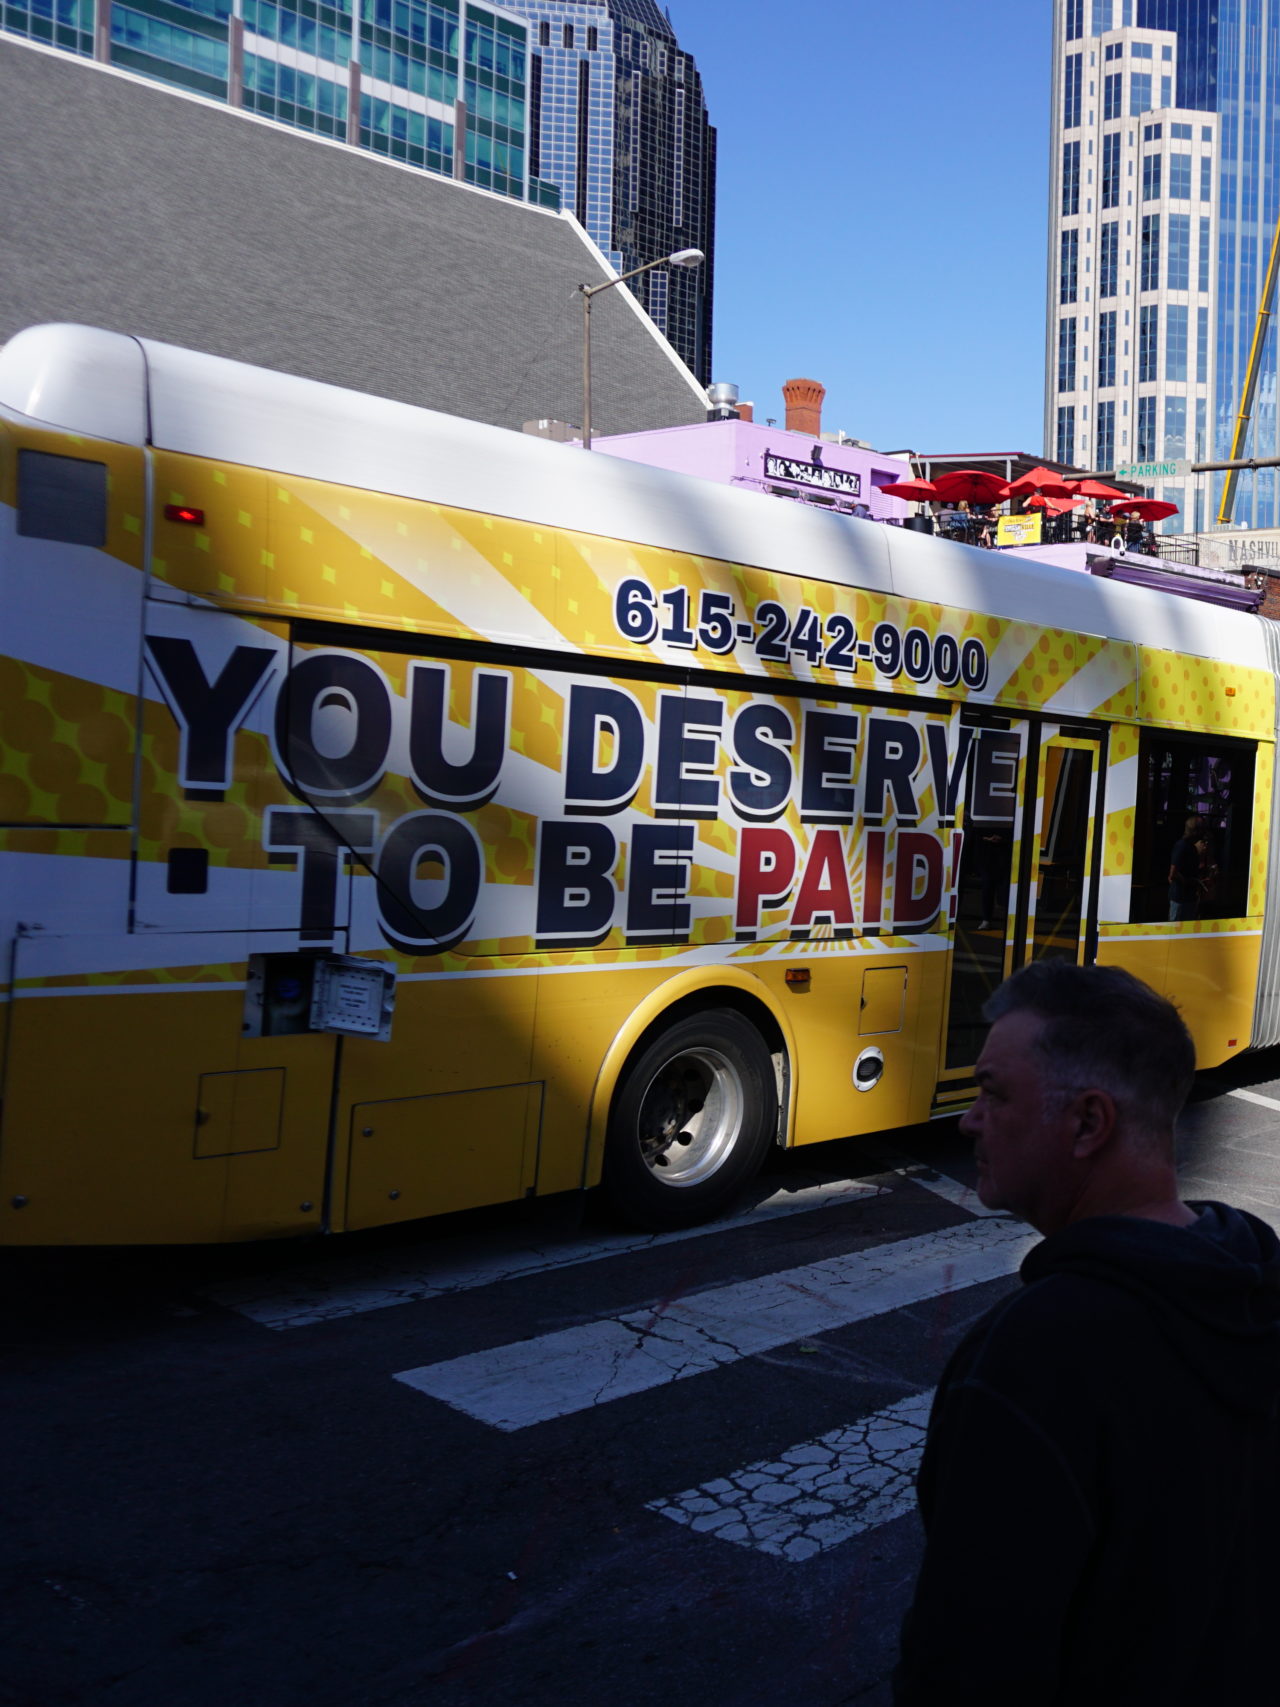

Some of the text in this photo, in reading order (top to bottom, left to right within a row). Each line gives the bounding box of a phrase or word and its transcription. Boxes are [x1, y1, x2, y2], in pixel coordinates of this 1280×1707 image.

[1130, 462, 1177, 477] PARKING
[615, 577, 988, 691] 615-242-9000
[145, 636, 1019, 827] YOU DESERVE
[264, 806, 964, 954] TO BE PAID!
